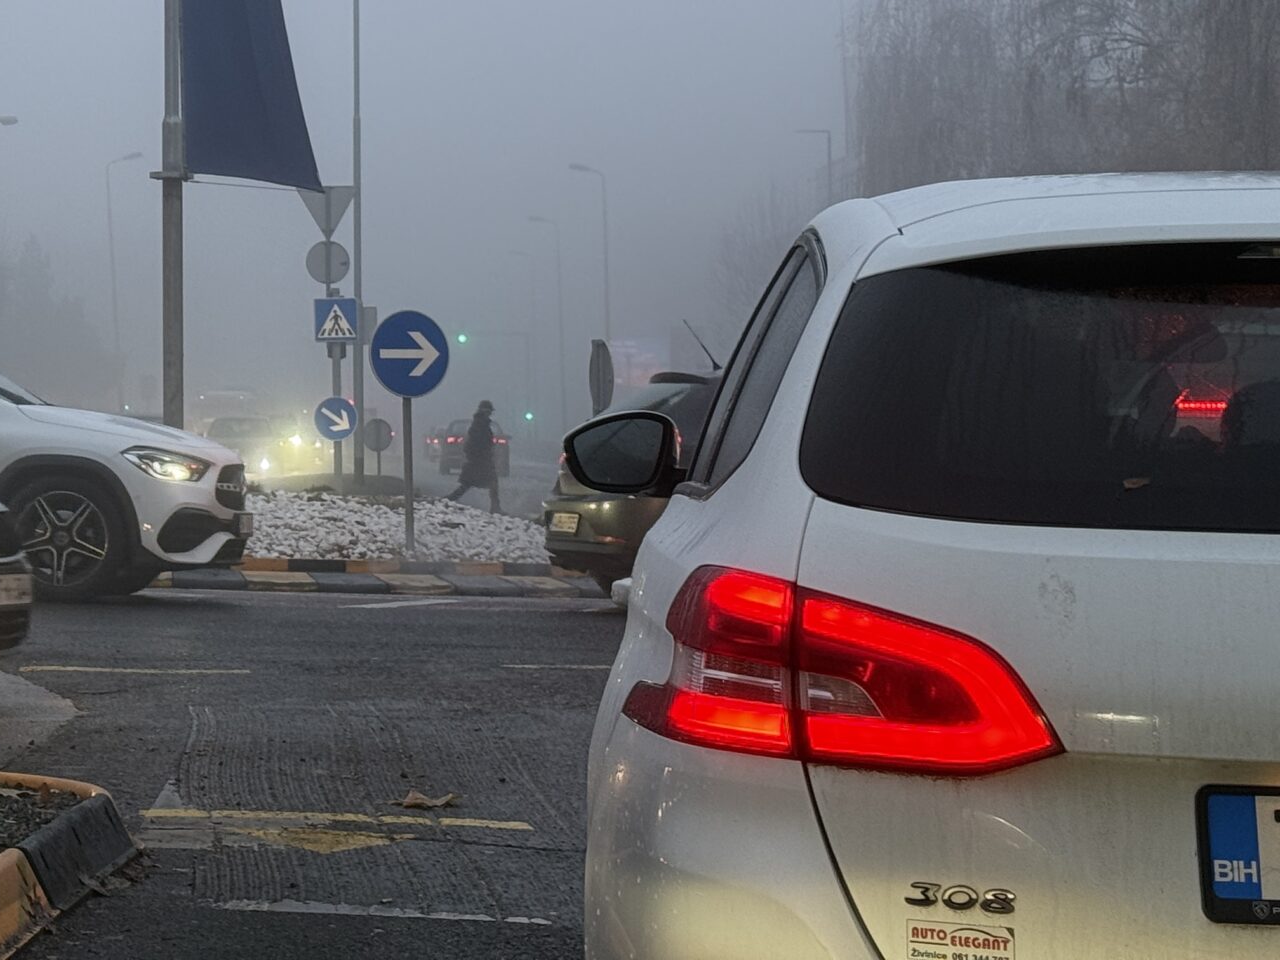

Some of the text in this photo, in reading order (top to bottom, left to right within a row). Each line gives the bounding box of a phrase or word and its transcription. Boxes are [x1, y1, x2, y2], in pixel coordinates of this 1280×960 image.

[1213, 859, 1259, 883] BIH
[904, 881, 1016, 914] 308
[911, 926, 948, 941] AUTO
[950, 935, 1010, 951] ELEGANT
